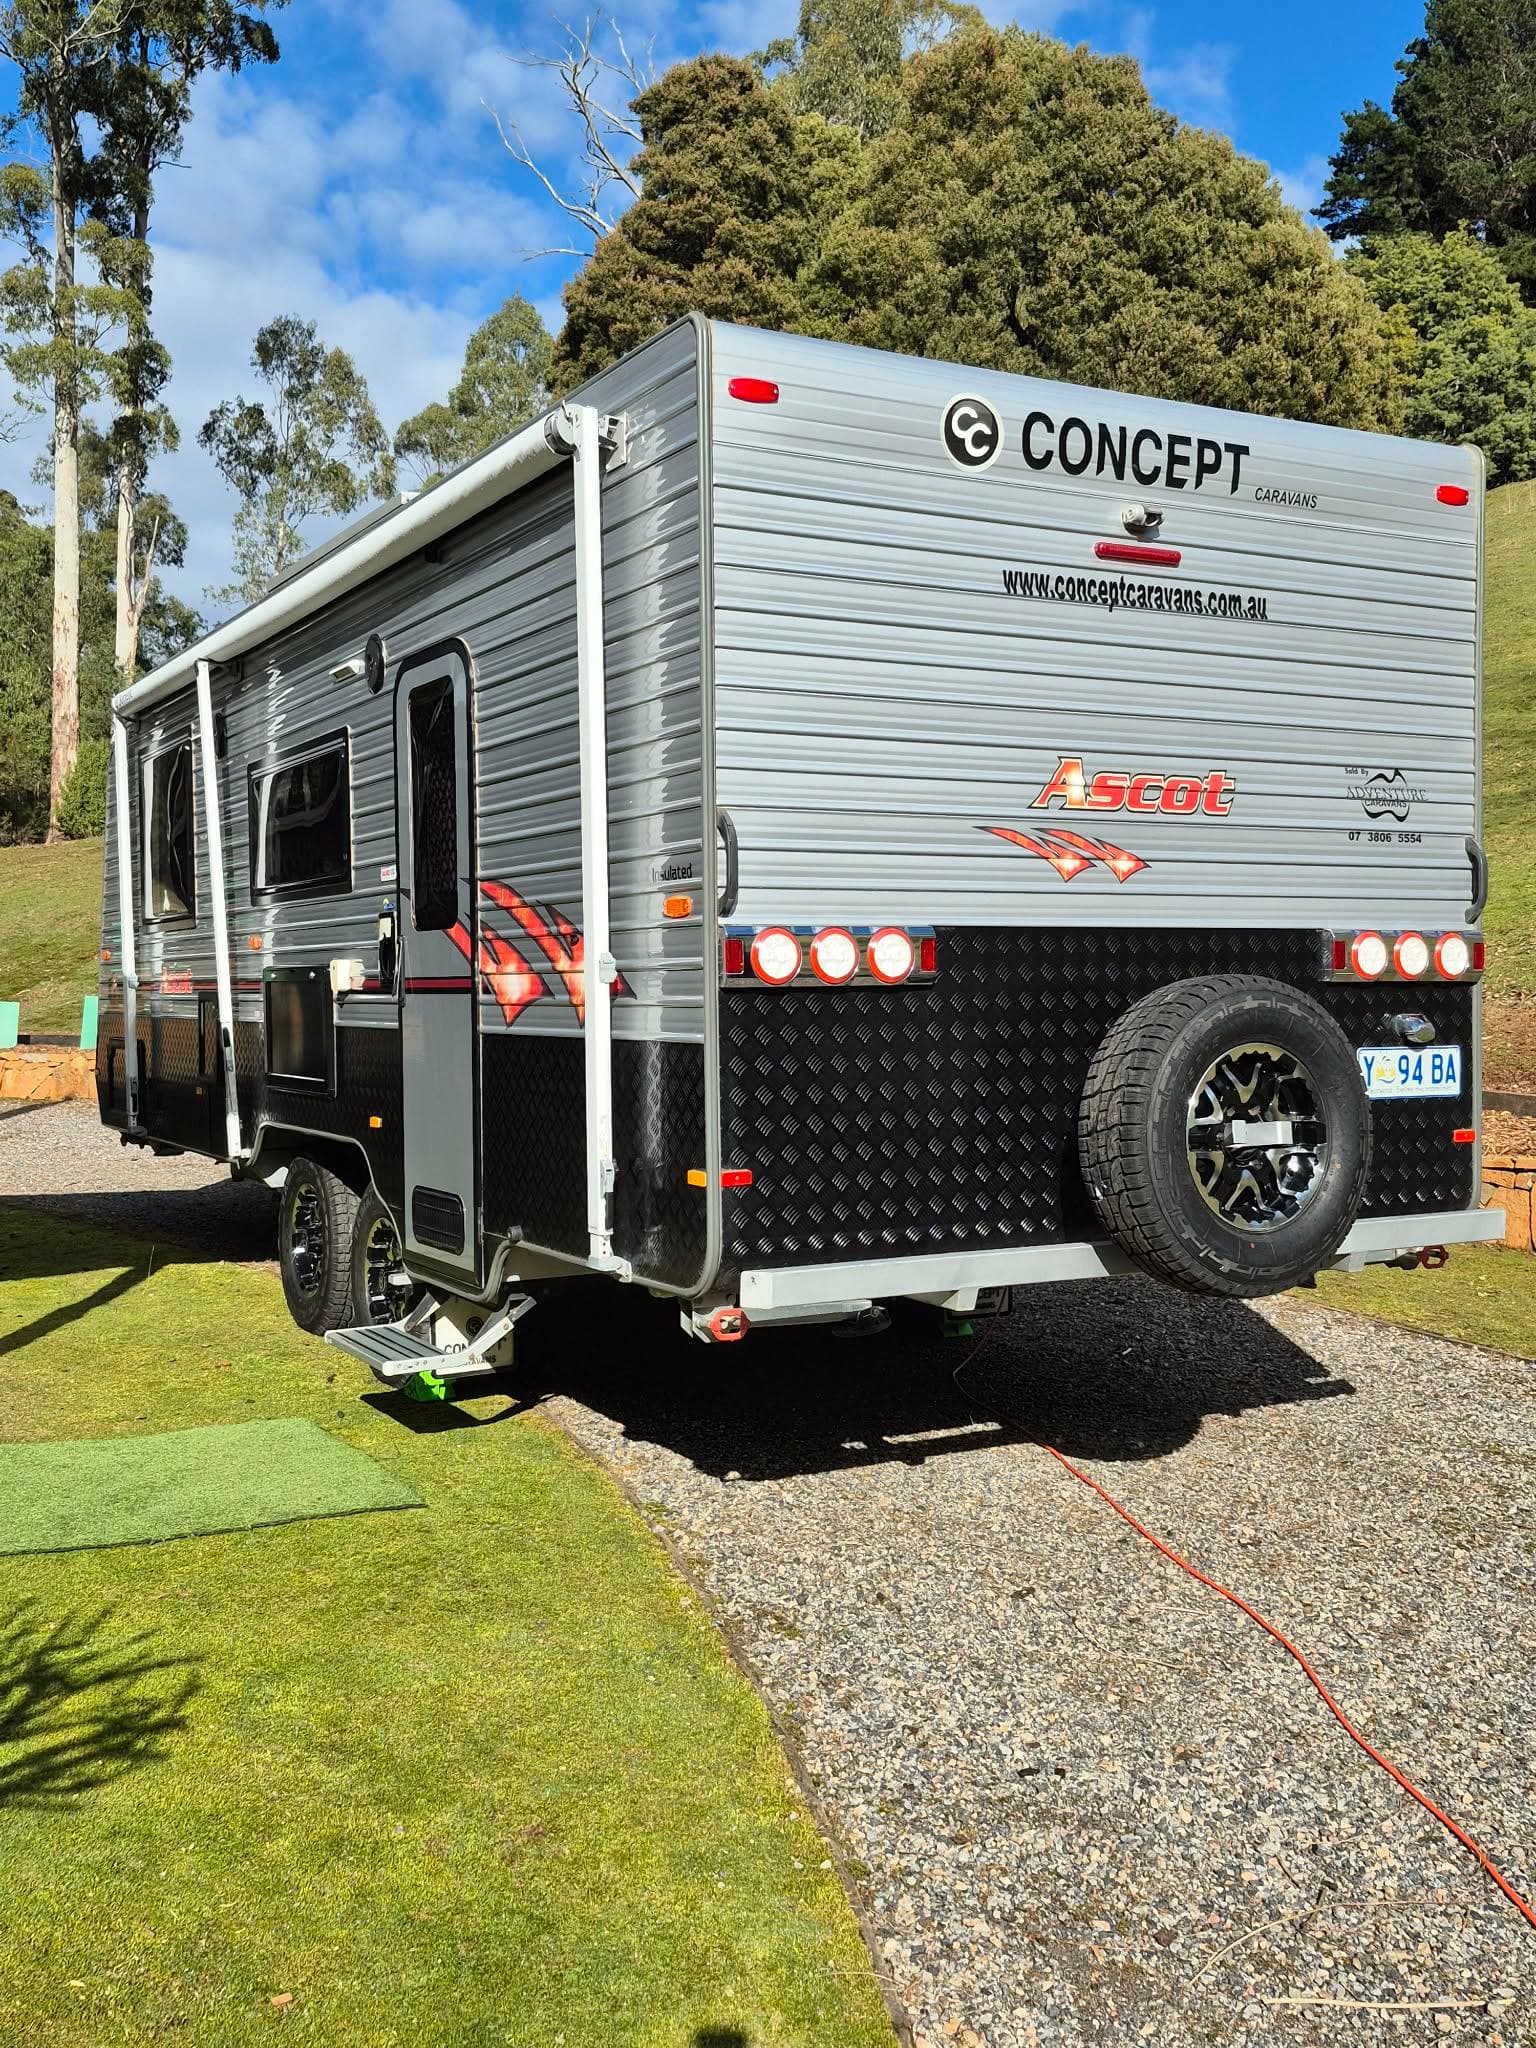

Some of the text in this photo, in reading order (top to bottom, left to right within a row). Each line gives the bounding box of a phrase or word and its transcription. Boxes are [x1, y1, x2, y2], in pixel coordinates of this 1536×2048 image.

[1022, 411, 1249, 496] CONCEPT
[1254, 487, 1318, 509] CARAVANS
[1003, 570, 1268, 619] www.conceptcaravans.com.au
[1027, 756, 1236, 816] Ascot
[1346, 786, 1428, 801] ADVENTURE
[1364, 800, 1407, 808] CARAVANS
[1348, 831, 1422, 843] 07 3806 5554
[652, 862, 693, 883] Insulated
[1398, 1054, 1423, 1085] 94
[1432, 1053, 1457, 1084] BA
